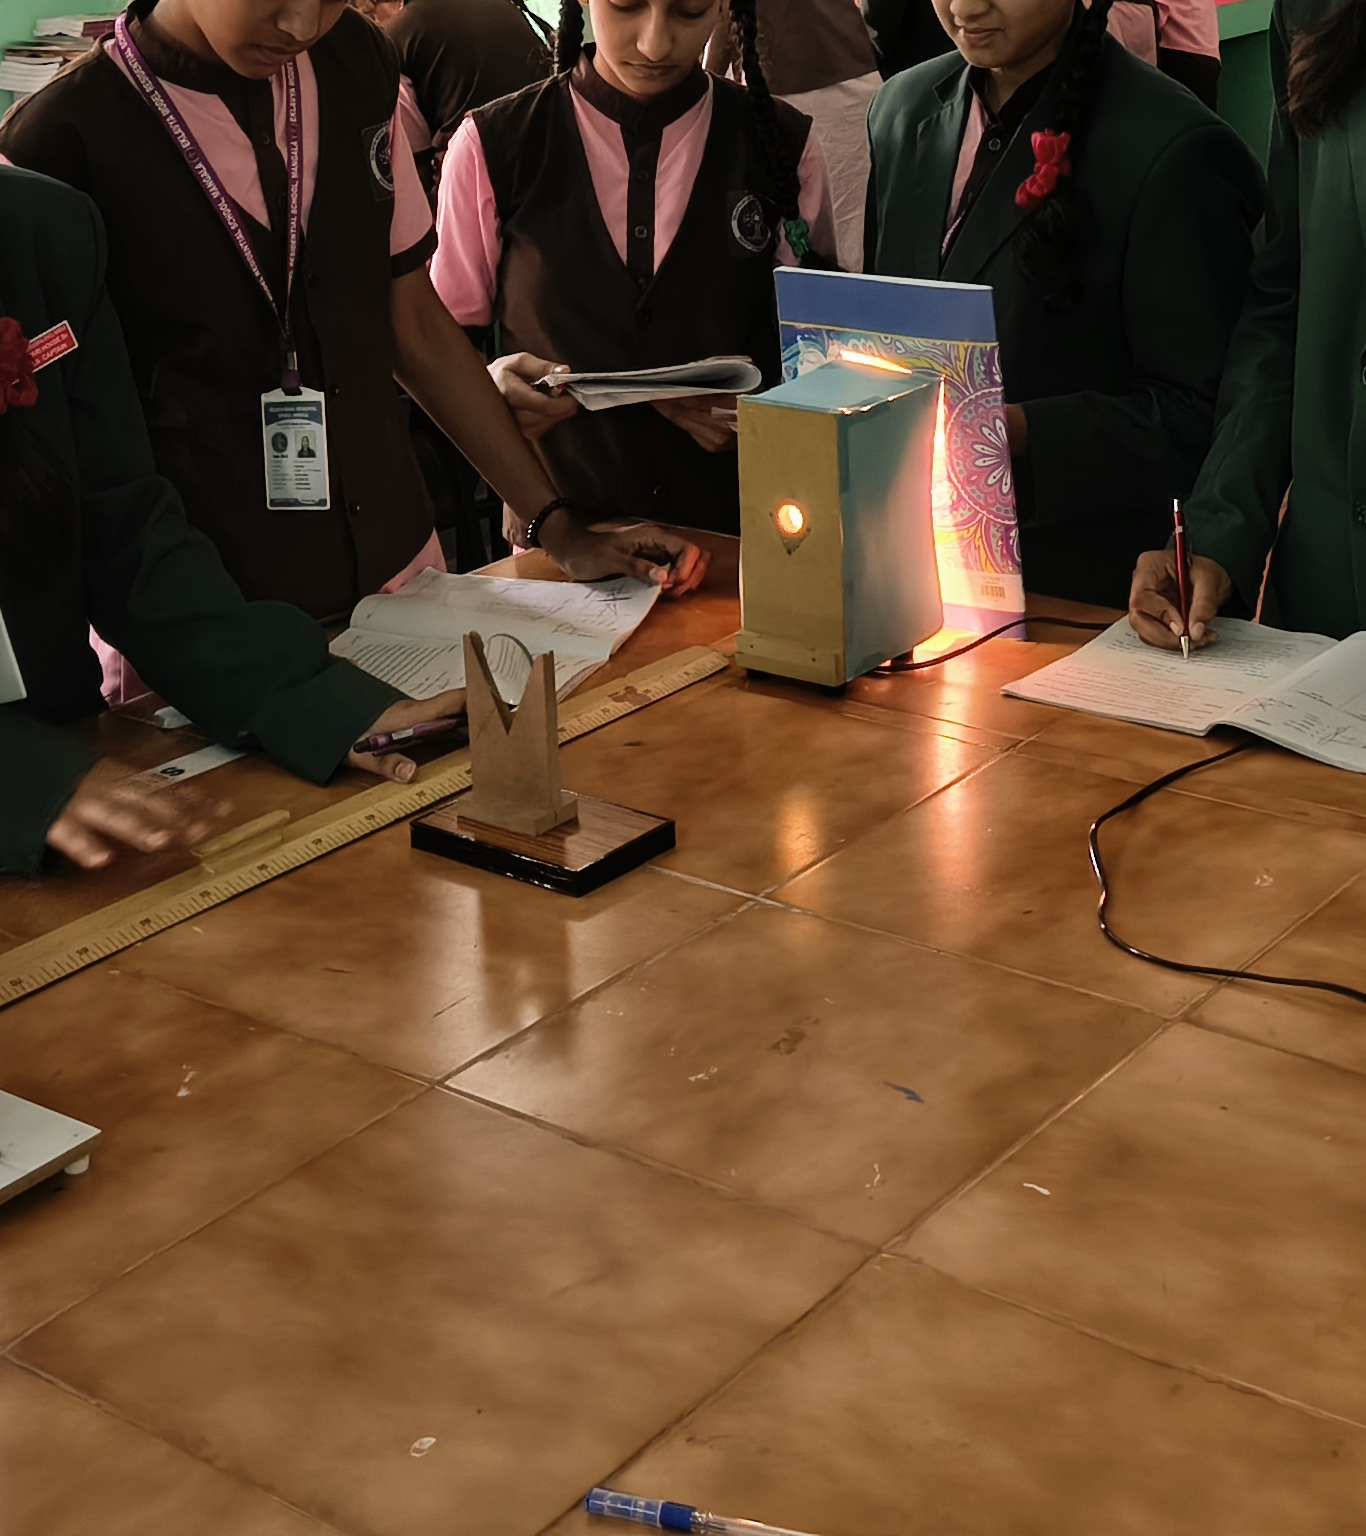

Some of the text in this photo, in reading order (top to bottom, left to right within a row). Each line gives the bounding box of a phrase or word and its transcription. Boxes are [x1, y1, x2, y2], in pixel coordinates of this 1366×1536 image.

[150, 90, 171, 116] MODEL
[166, 114, 190, 148] EKLAVYA
[290, 141, 300, 179] MANGALA
[194, 161, 221, 199] MANGALA
